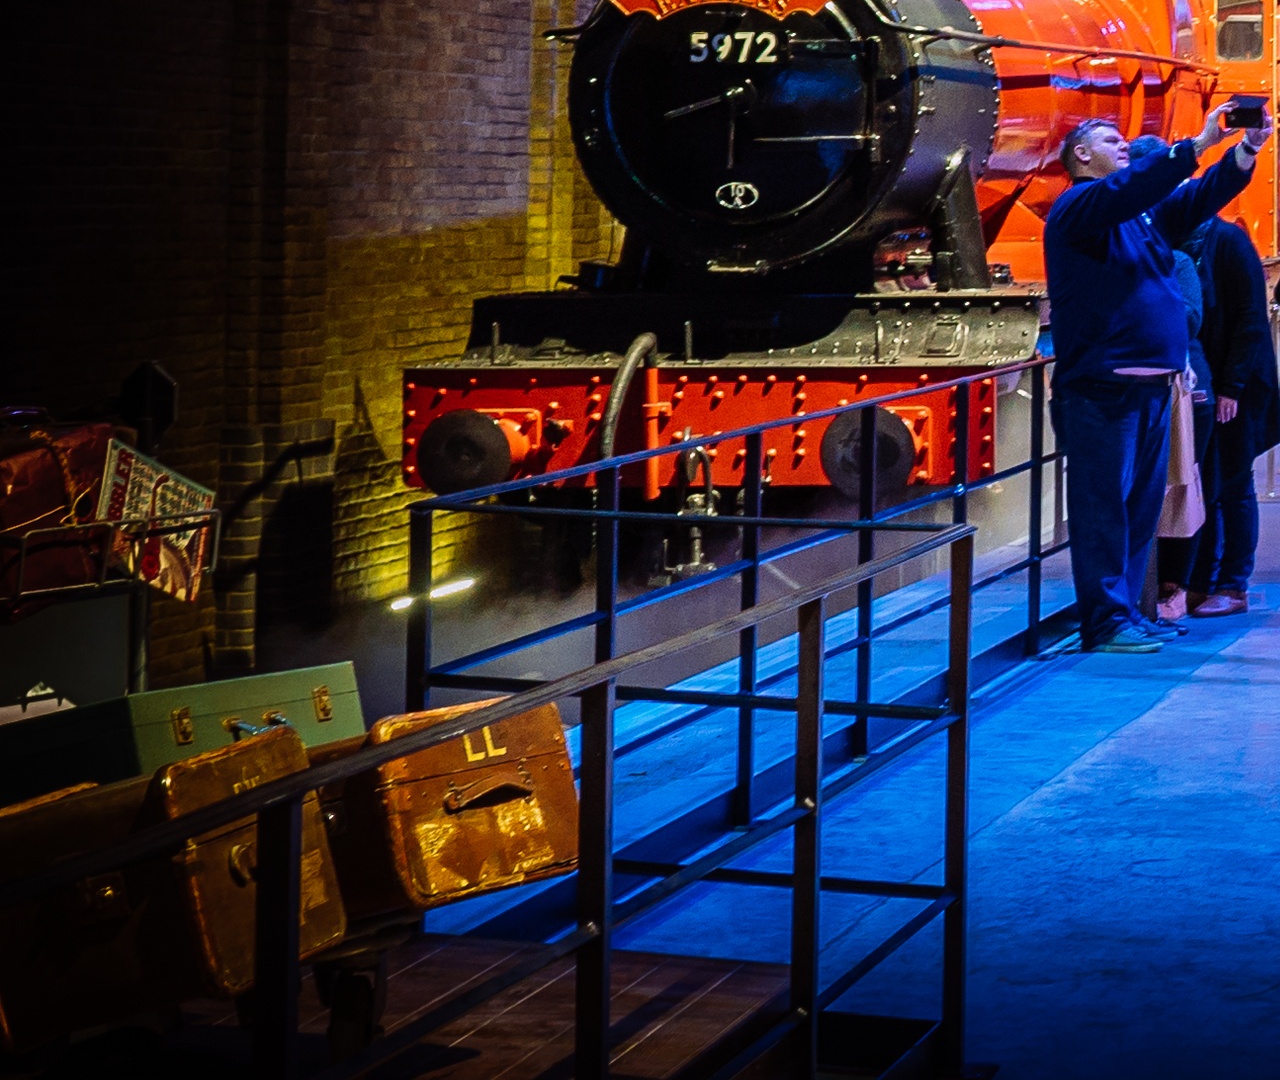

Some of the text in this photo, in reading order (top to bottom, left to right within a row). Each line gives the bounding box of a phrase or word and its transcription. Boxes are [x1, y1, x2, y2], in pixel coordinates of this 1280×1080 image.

[690, 32, 777, 63] 5972
[106, 448, 134, 521] BBLER
[463, 726, 507, 762] LL
